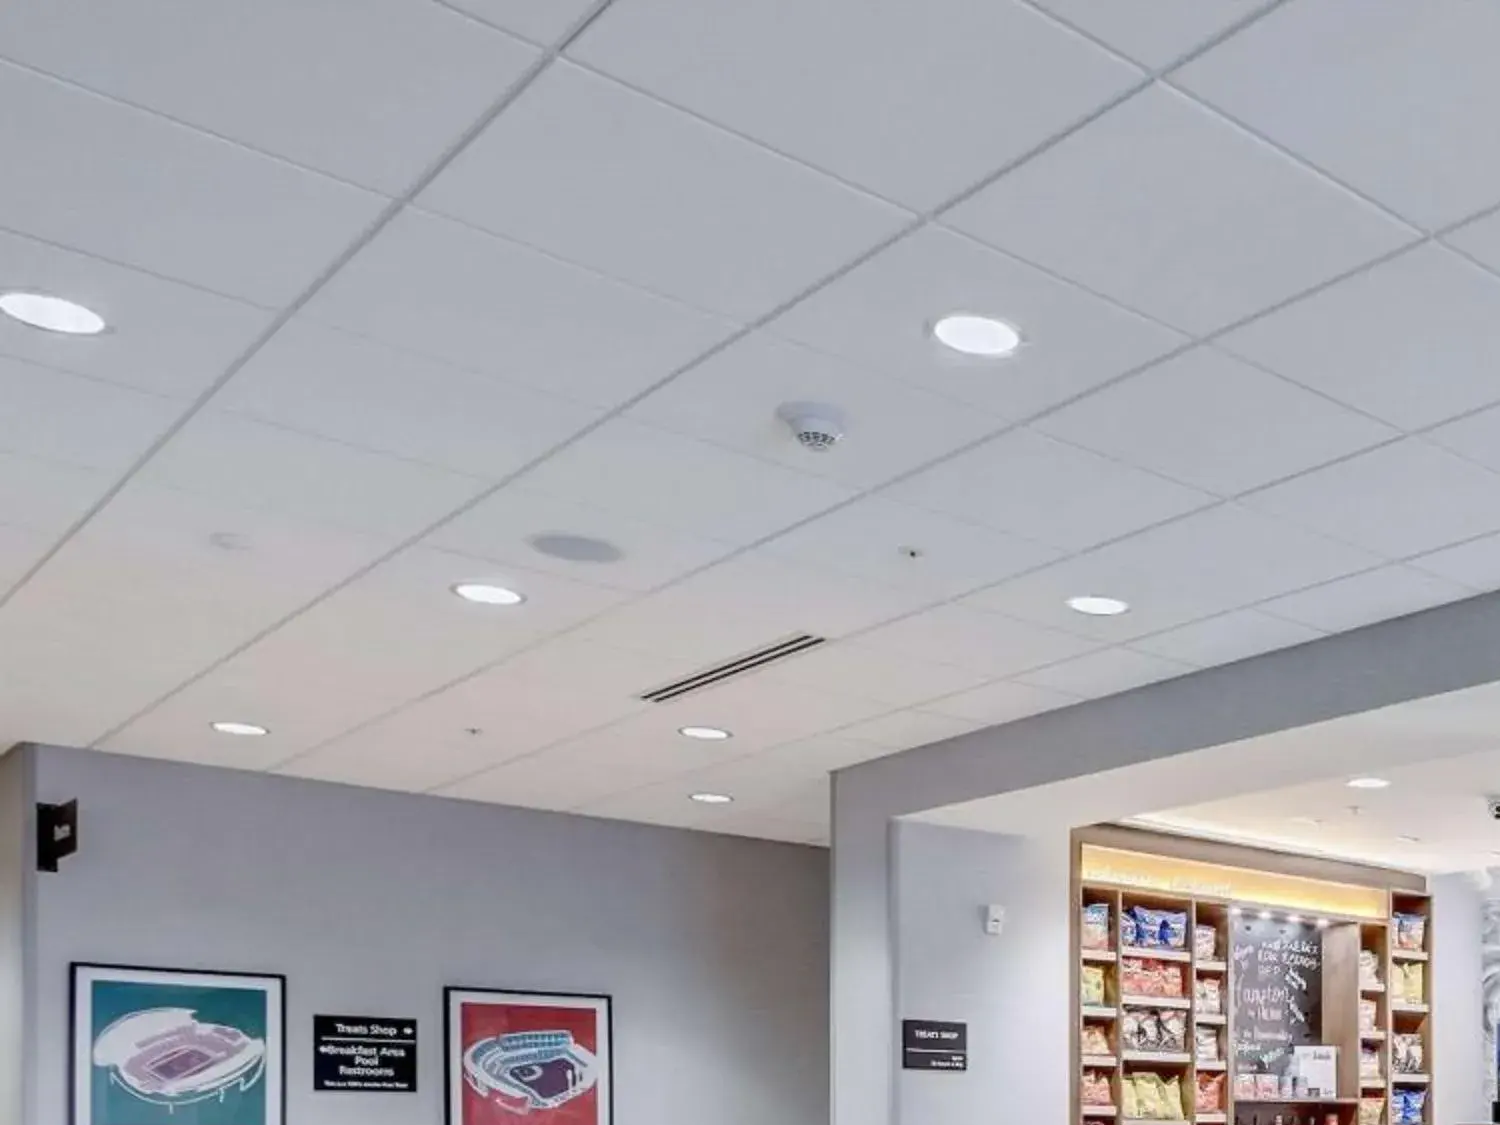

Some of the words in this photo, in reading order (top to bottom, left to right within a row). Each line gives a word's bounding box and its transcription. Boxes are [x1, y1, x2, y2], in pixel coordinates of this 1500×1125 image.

[370, 1024, 397, 1036] Shop
[327, 1045, 377, 1056] Breakfast
[380, 1047, 406, 1057] Area
[354, 1055, 378, 1066] Pool
[339, 1066, 394, 1077] Restrooms
